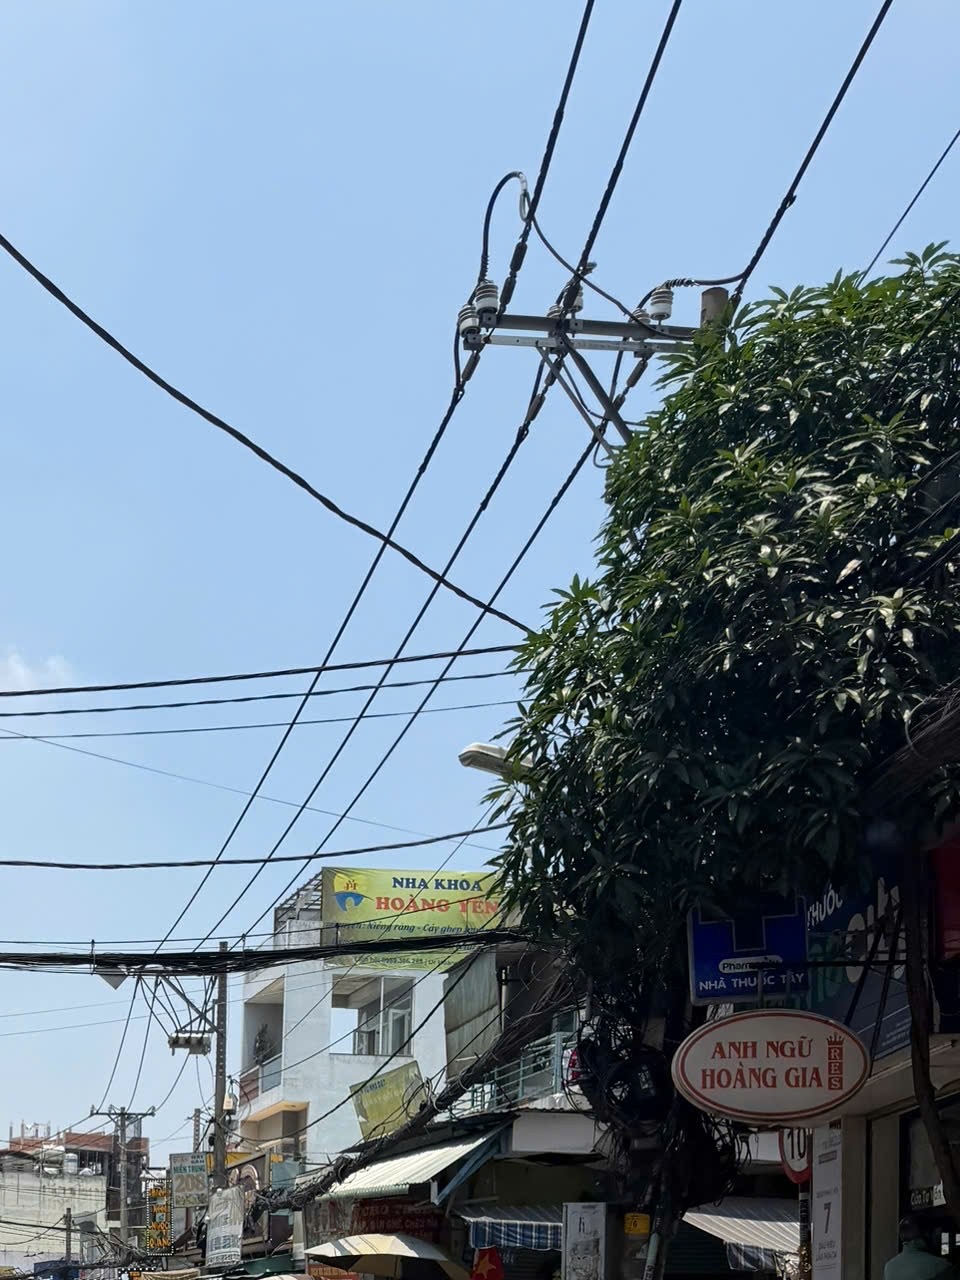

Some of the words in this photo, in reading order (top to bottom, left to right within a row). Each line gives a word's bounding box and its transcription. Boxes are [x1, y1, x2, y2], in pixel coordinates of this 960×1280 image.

[392, 877, 429, 890] NHA
[434, 879, 483, 892] KHOA
[375, 894, 451, 913] HOÀNG
[699, 976, 727, 991] NHÀ
[711, 1041, 757, 1059] ANH
[765, 1036, 814, 1059] NGỮ
[701, 1063, 777, 1089] HOÀNG
[784, 1067, 823, 1089] GIA
[824, 1202, 832, 1234] 7
